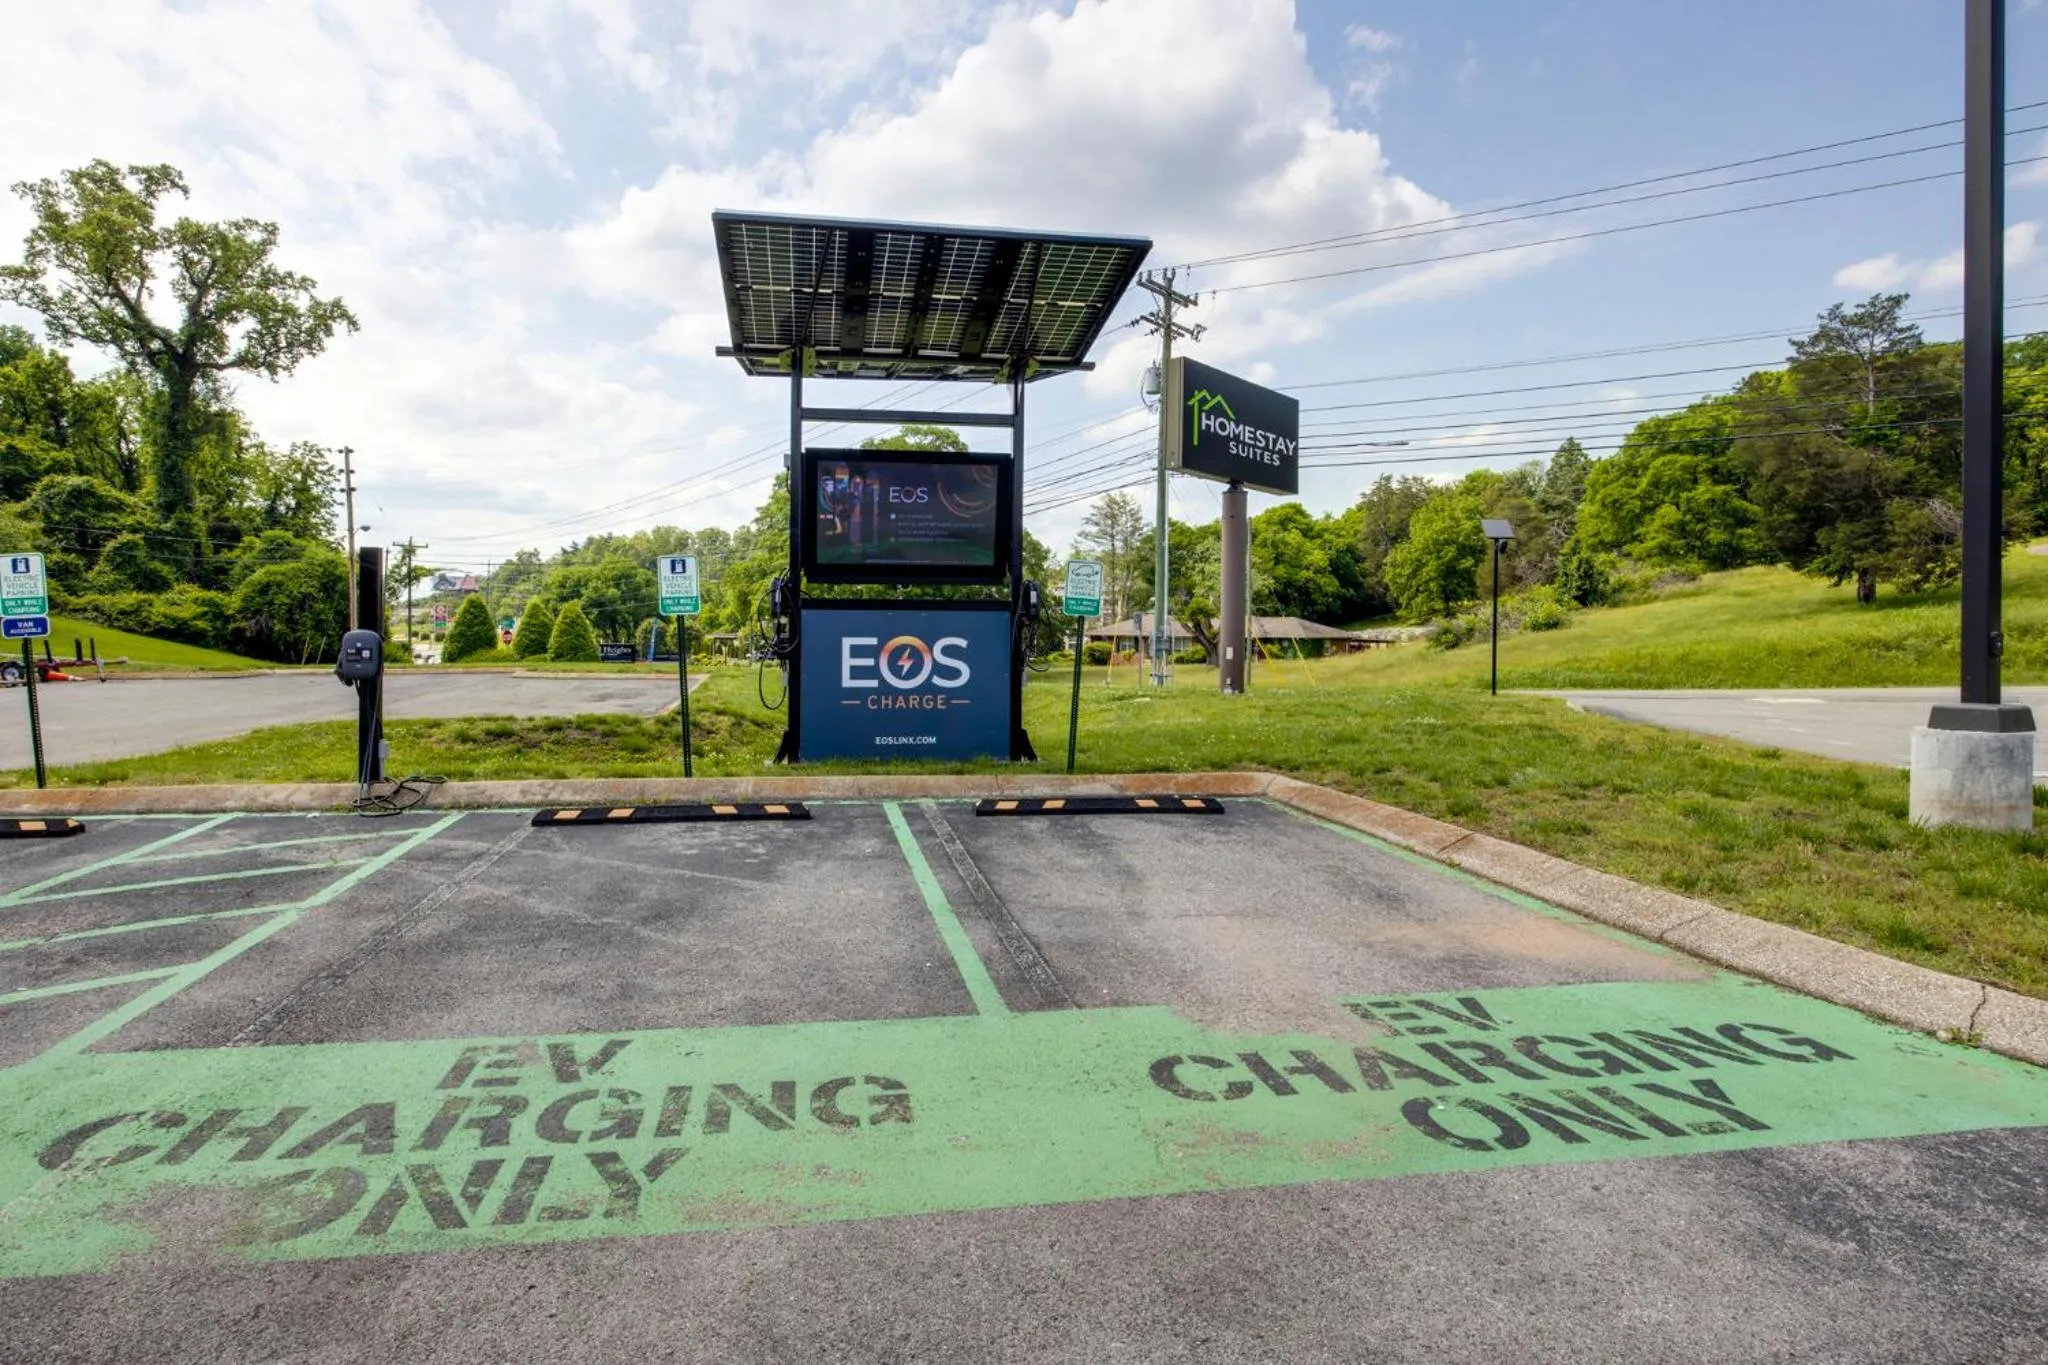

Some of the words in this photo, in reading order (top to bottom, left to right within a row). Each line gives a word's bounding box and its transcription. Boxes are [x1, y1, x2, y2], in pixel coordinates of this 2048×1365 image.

[1201, 411, 1297, 456] HOMESTAY
[1228, 441, 1281, 466] SUITES
[888, 486, 928, 503] EOS
[17, 620, 34, 628] VAN
[841, 635, 970, 689] EOS
[867, 695, 947, 710] CHARGE
[875, 736, 937, 745] EOSLINX.COM
[1340, 996, 1500, 1036] EV
[436, 1038, 634, 1091] EV
[1149, 1022, 1856, 1101] CHARGING
[37, 1075, 913, 1170] CHARGING
[1400, 1079, 1772, 1151] ONLY
[238, 1148, 690, 1245] ONLY
